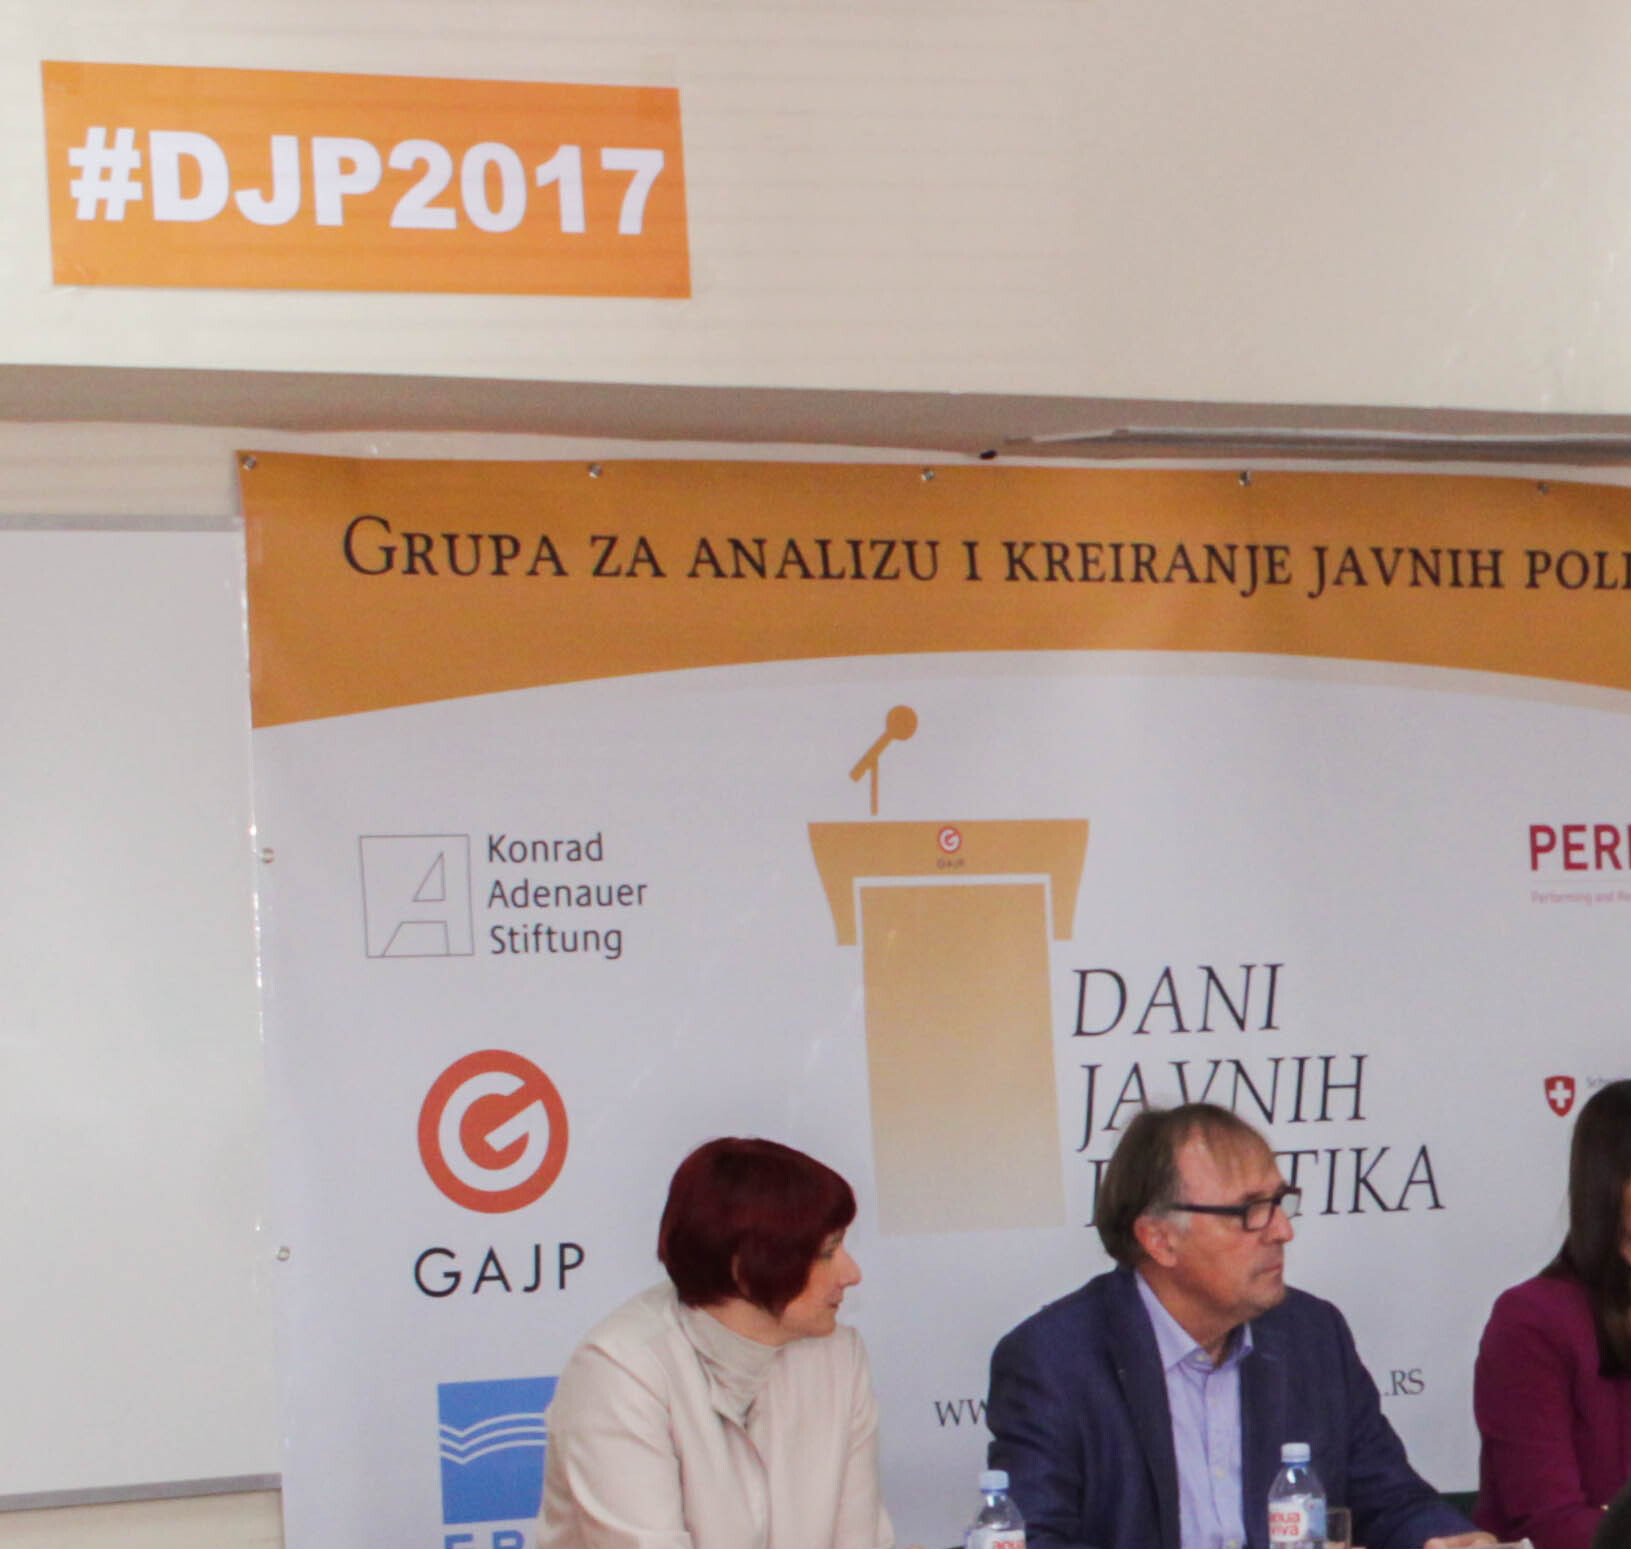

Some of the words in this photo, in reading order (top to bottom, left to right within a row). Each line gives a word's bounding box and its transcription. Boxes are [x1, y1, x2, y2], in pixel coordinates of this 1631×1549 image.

[67, 125, 666, 236] #DJP2017
[343, 514, 568, 577] GRUPA
[589, 533, 667, 579] ZA
[686, 535, 941, 582] ANALIZU
[962, 539, 983, 582] I
[1003, 540, 1293, 598] KREIRANJE
[1307, 545, 1505, 600] JAVNIH
[488, 832, 604, 864] Konrad
[487, 878, 649, 910] Adenauer
[489, 923, 624, 961] Stiftung
[1071, 962, 1285, 1038] DANI
[1075, 1053, 1369, 1154] JAVNIH
[1083, 1143, 1446, 1228] TIKA
[412, 1242, 586, 1299] GAJP
